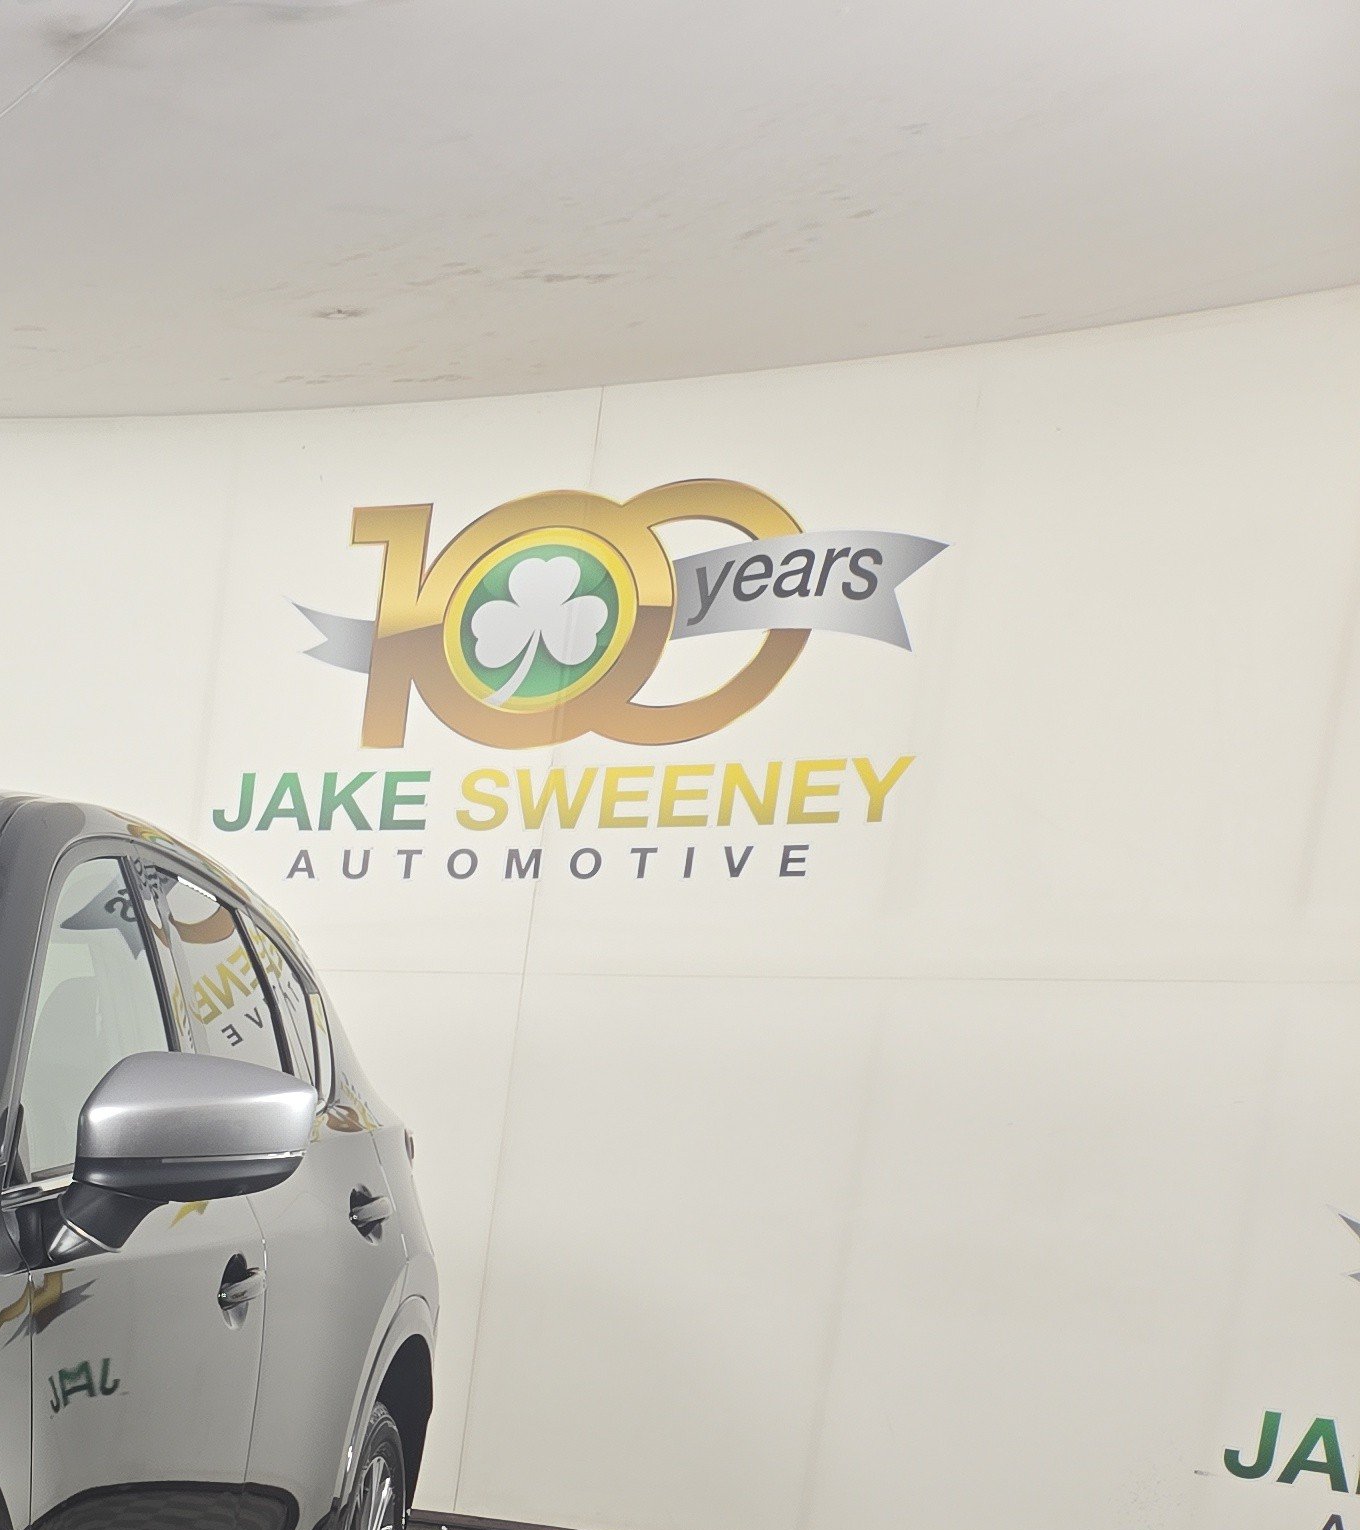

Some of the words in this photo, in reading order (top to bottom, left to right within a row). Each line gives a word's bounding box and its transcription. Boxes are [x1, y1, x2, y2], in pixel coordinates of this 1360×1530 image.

[686, 541, 883, 627] years
[212, 770, 431, 832] JAKE
[456, 755, 917, 831] SWEENEY
[287, 843, 810, 881] AUTOMOTIVE
[1223, 1410, 1360, 1495] JA
